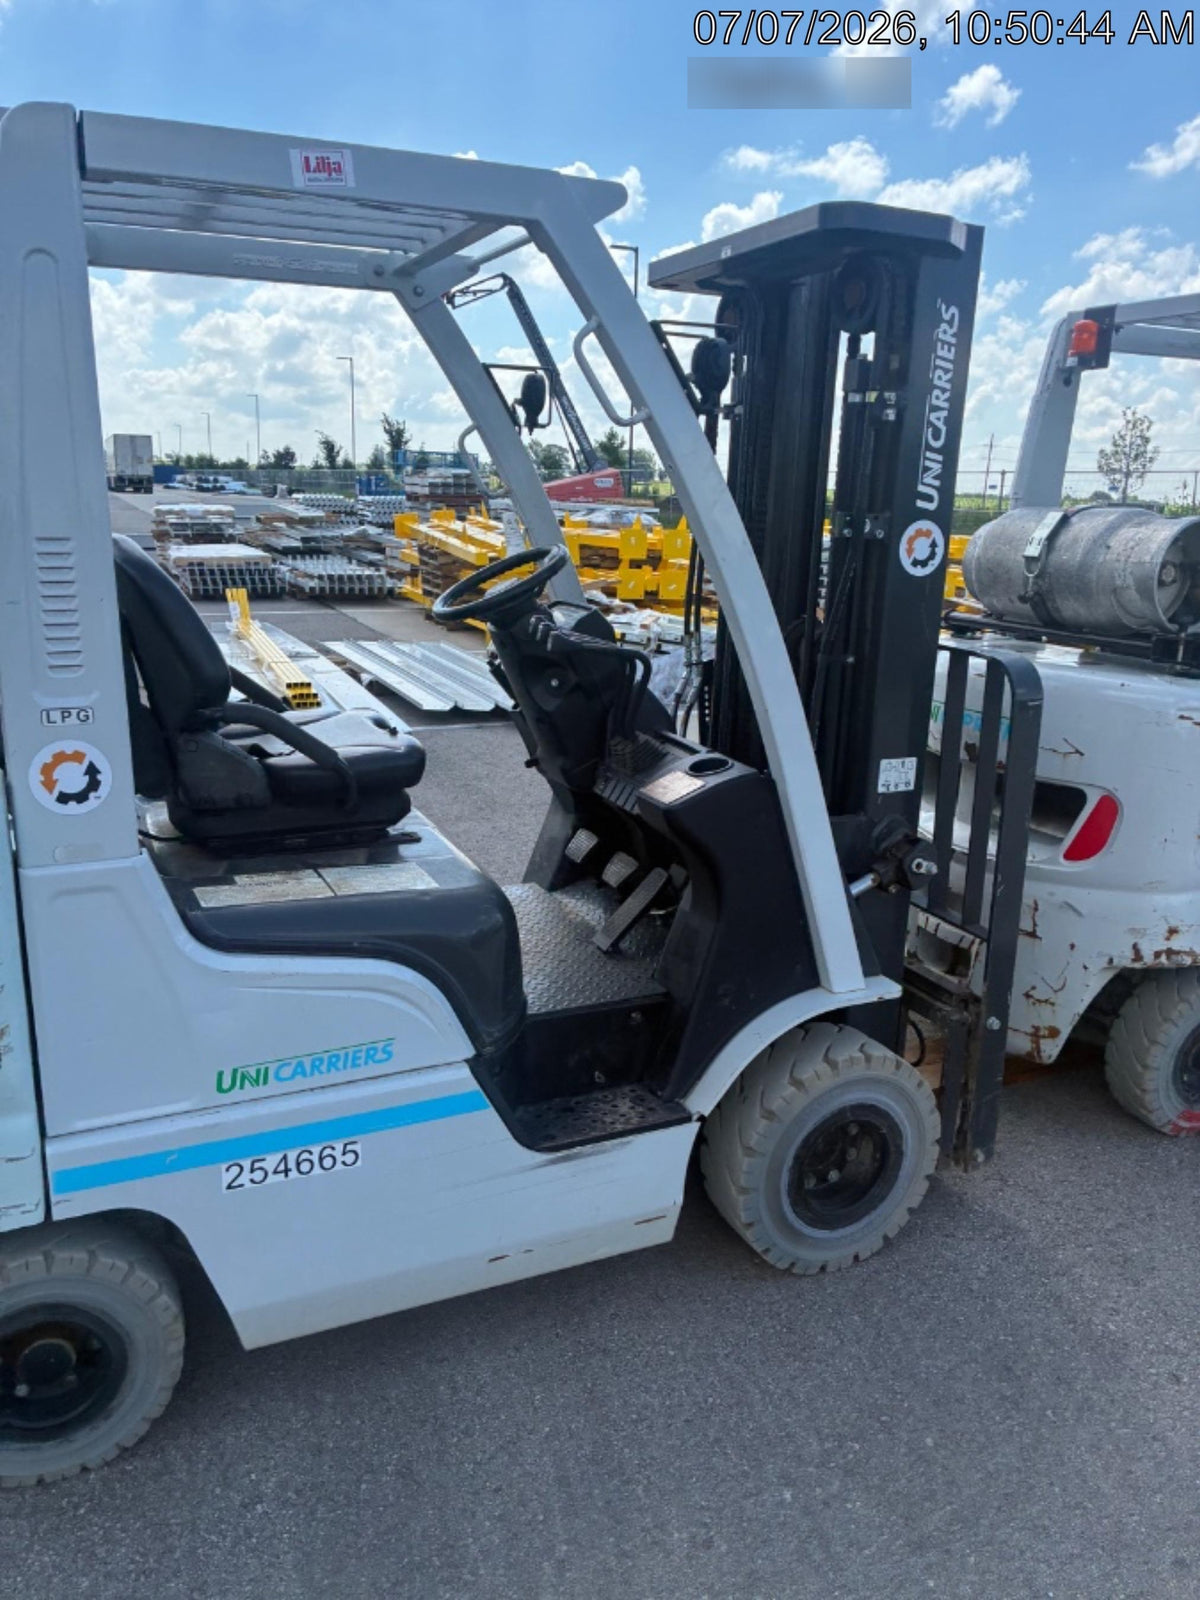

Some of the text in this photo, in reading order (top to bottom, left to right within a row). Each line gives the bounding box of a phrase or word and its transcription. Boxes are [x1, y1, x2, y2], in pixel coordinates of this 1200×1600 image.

[304, 156, 342, 177] Lilja
[45, 708, 90, 724] LPG
[225, 1140, 360, 1190] 254665
